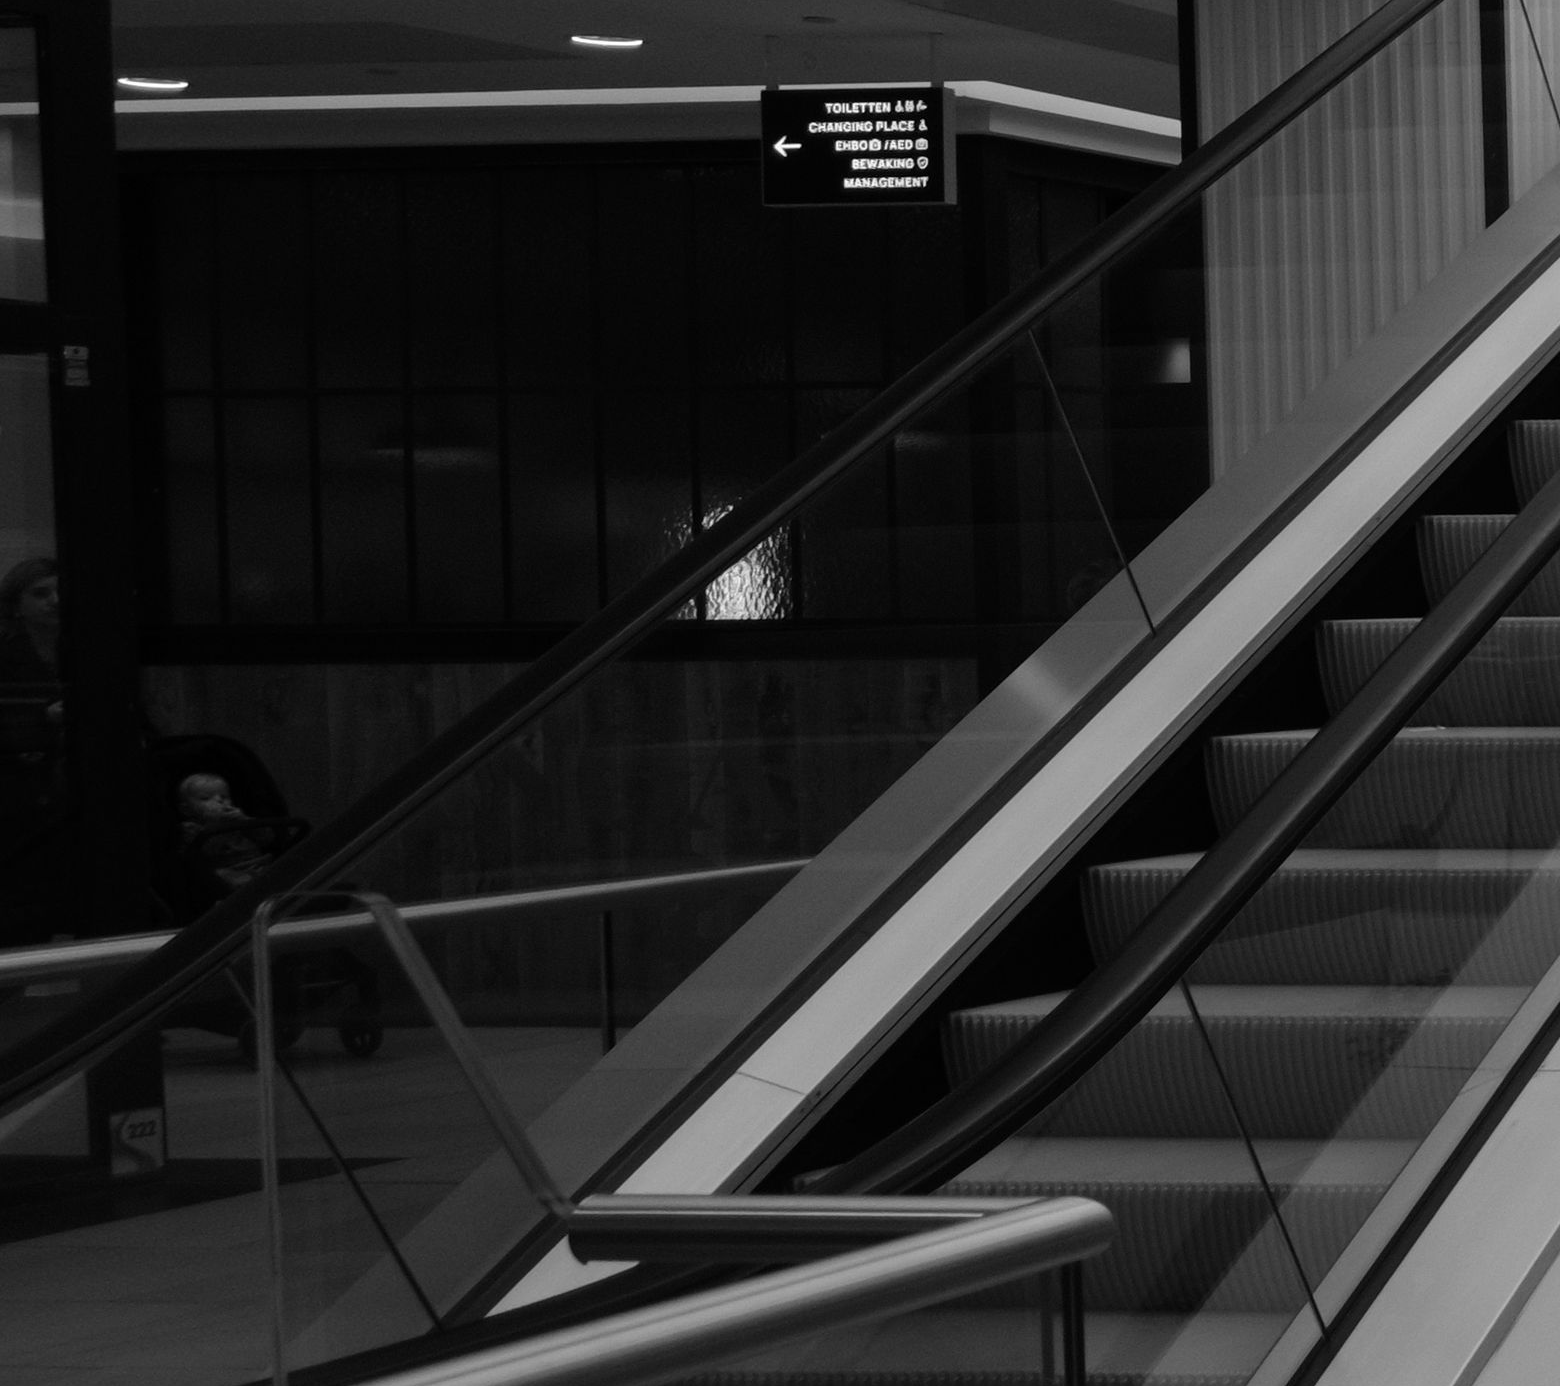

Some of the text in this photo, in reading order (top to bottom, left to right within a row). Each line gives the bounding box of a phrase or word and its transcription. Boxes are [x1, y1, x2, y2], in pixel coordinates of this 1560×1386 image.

[825, 102, 891, 114] TOILETTEN
[808, 120, 915, 133] CHANGING PLACE
[835, 140, 867, 151] EHBO
[851, 158, 915, 170] BEWAKING
[843, 176, 929, 189] MANAGEMENT
